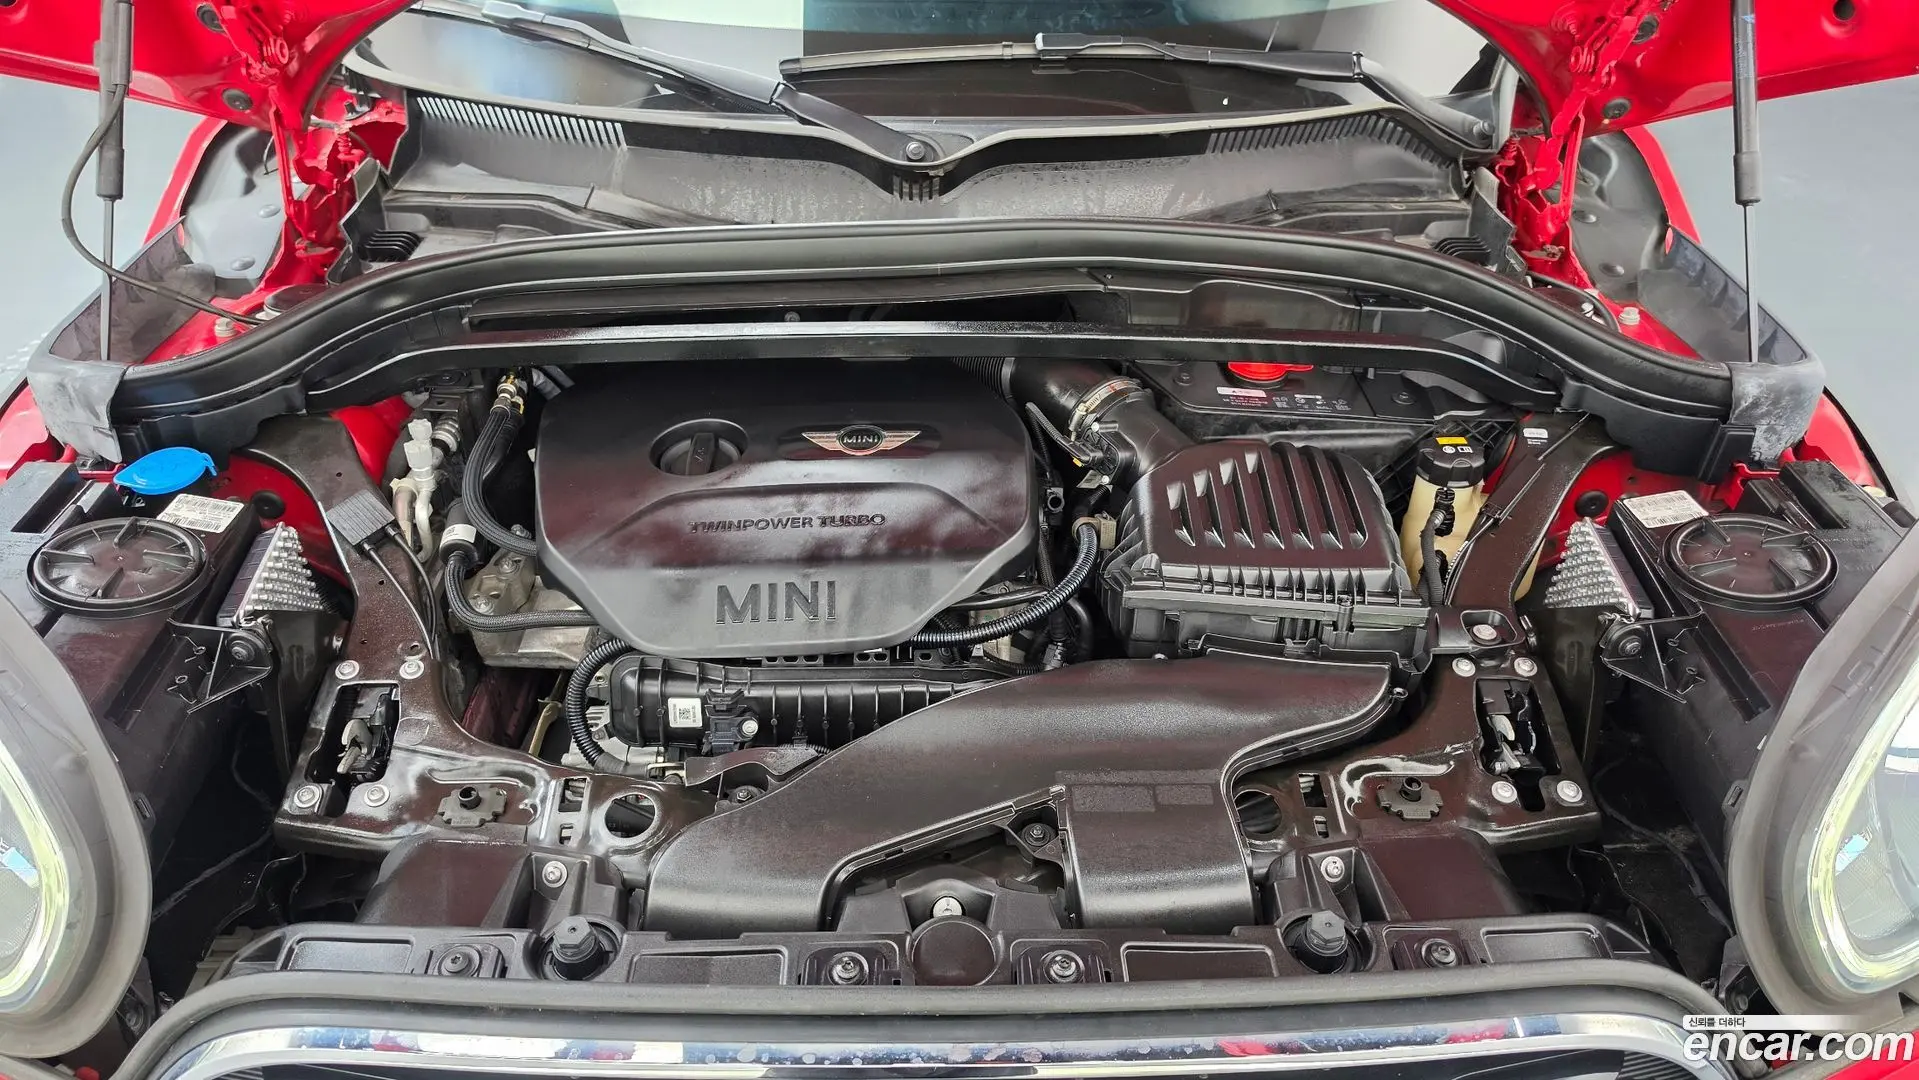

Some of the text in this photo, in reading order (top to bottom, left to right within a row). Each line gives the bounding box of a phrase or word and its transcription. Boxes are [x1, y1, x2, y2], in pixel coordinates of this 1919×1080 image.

[843, 434, 878, 444] MINI
[690, 513, 886, 533] TWINPOWER TURBO
[716, 580, 836, 624] MINI
